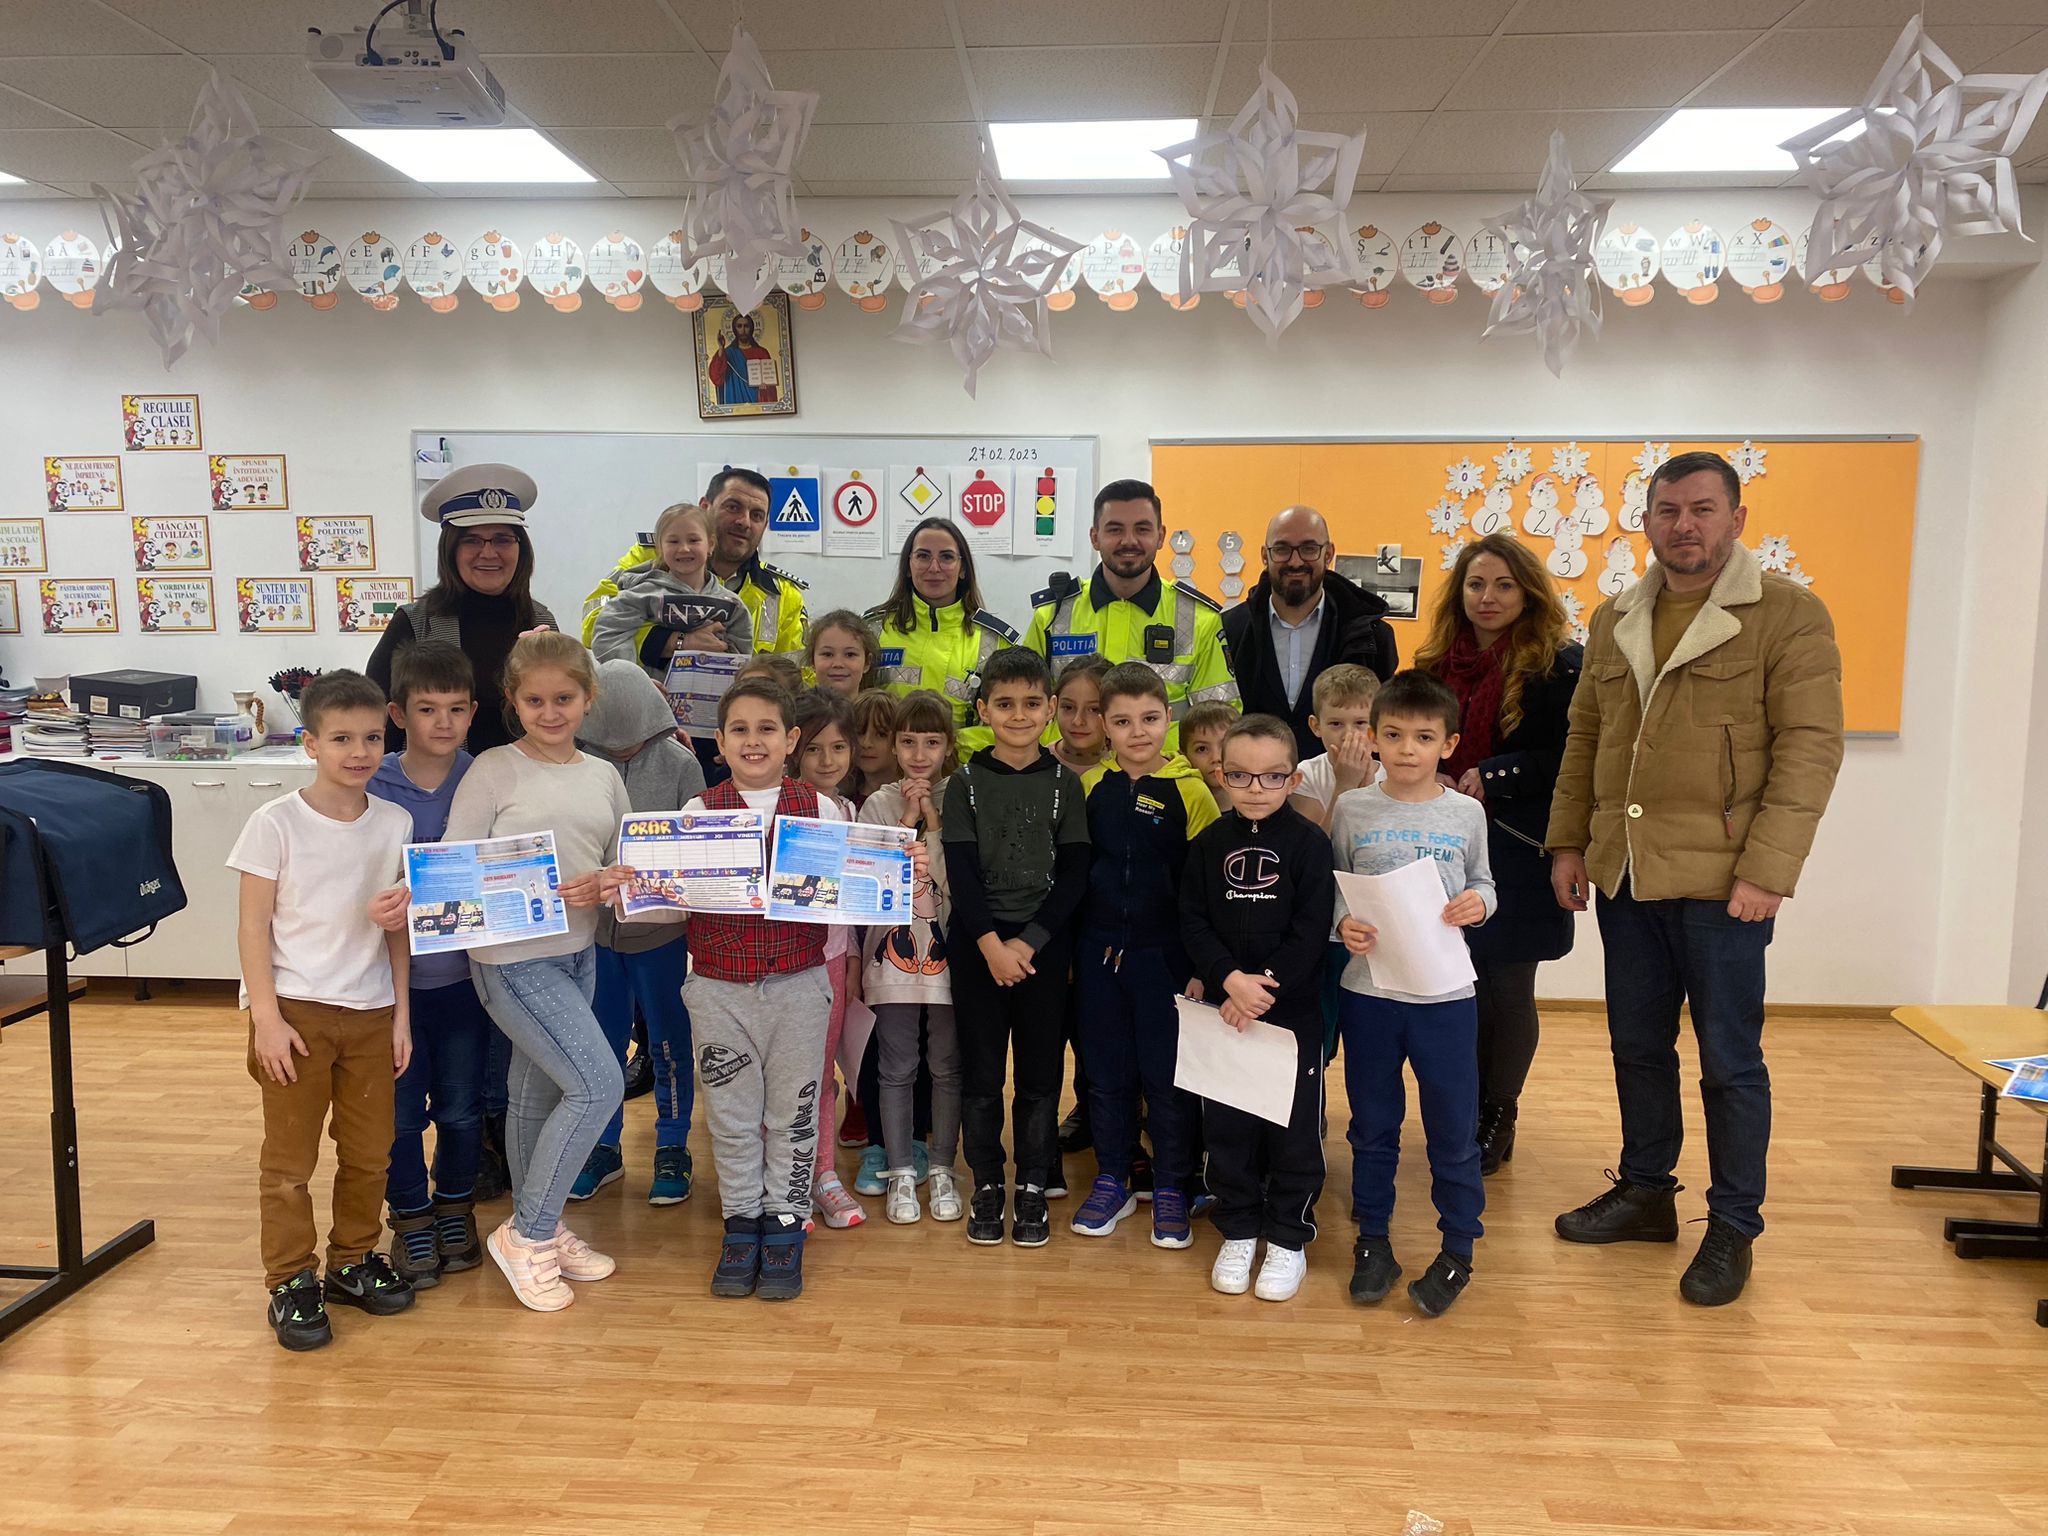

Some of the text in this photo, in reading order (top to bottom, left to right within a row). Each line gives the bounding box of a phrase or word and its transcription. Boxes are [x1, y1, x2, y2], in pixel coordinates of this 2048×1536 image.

[1408, 235, 1431, 249] t T
[1605, 235, 1632, 249] v V
[1669, 234, 1705, 247] w W
[1736, 232, 1763, 246] x X
[289, 244, 315, 257] d D
[350, 245, 373, 258] e E
[411, 245, 431, 257] f F
[470, 244, 496, 261] g G
[550, 245, 561, 257] H
[854, 244, 862, 257] L
[1088, 242, 1113, 256] p P
[1153, 244, 1162, 256] q
[143, 402, 192, 414] REGULILE
[151, 415, 190, 428] CLASEI
[1565, 456, 1573, 468] 5
[1461, 472, 1469, 482] 0
[963, 493, 1004, 513] STOP
[1444, 510, 1451, 521] 0
[1533, 509, 1551, 534] 2
[1579, 509, 1594, 533] 4
[1630, 506, 1643, 529] 6
[323, 520, 356, 528] SUNTEM
[1483, 512, 1499, 534] 0
[12, 527, 21, 535] LA
[22, 525, 40, 535] TIMP
[154, 530, 202, 539] CIVILIZAT!
[1176, 535, 1187, 547] 4
[1225, 536, 1235, 549] 5
[1770, 548, 1777, 559] 4
[1557, 551, 1572, 576] 3
[159, 583, 186, 591] VORBIM
[256, 583, 307, 594] SUNTEM BUNI
[369, 582, 398, 591] SUNTEM
[1608, 572, 1626, 595] 5
[262, 594, 302, 605] PRIETENI!
[383, 592, 392, 600] LA
[392, 591, 408, 600] ORE!
[628, 819, 672, 836] ORAR
[1386, 829, 1422, 842] EVER
[1225, 889, 1278, 903] Champion
